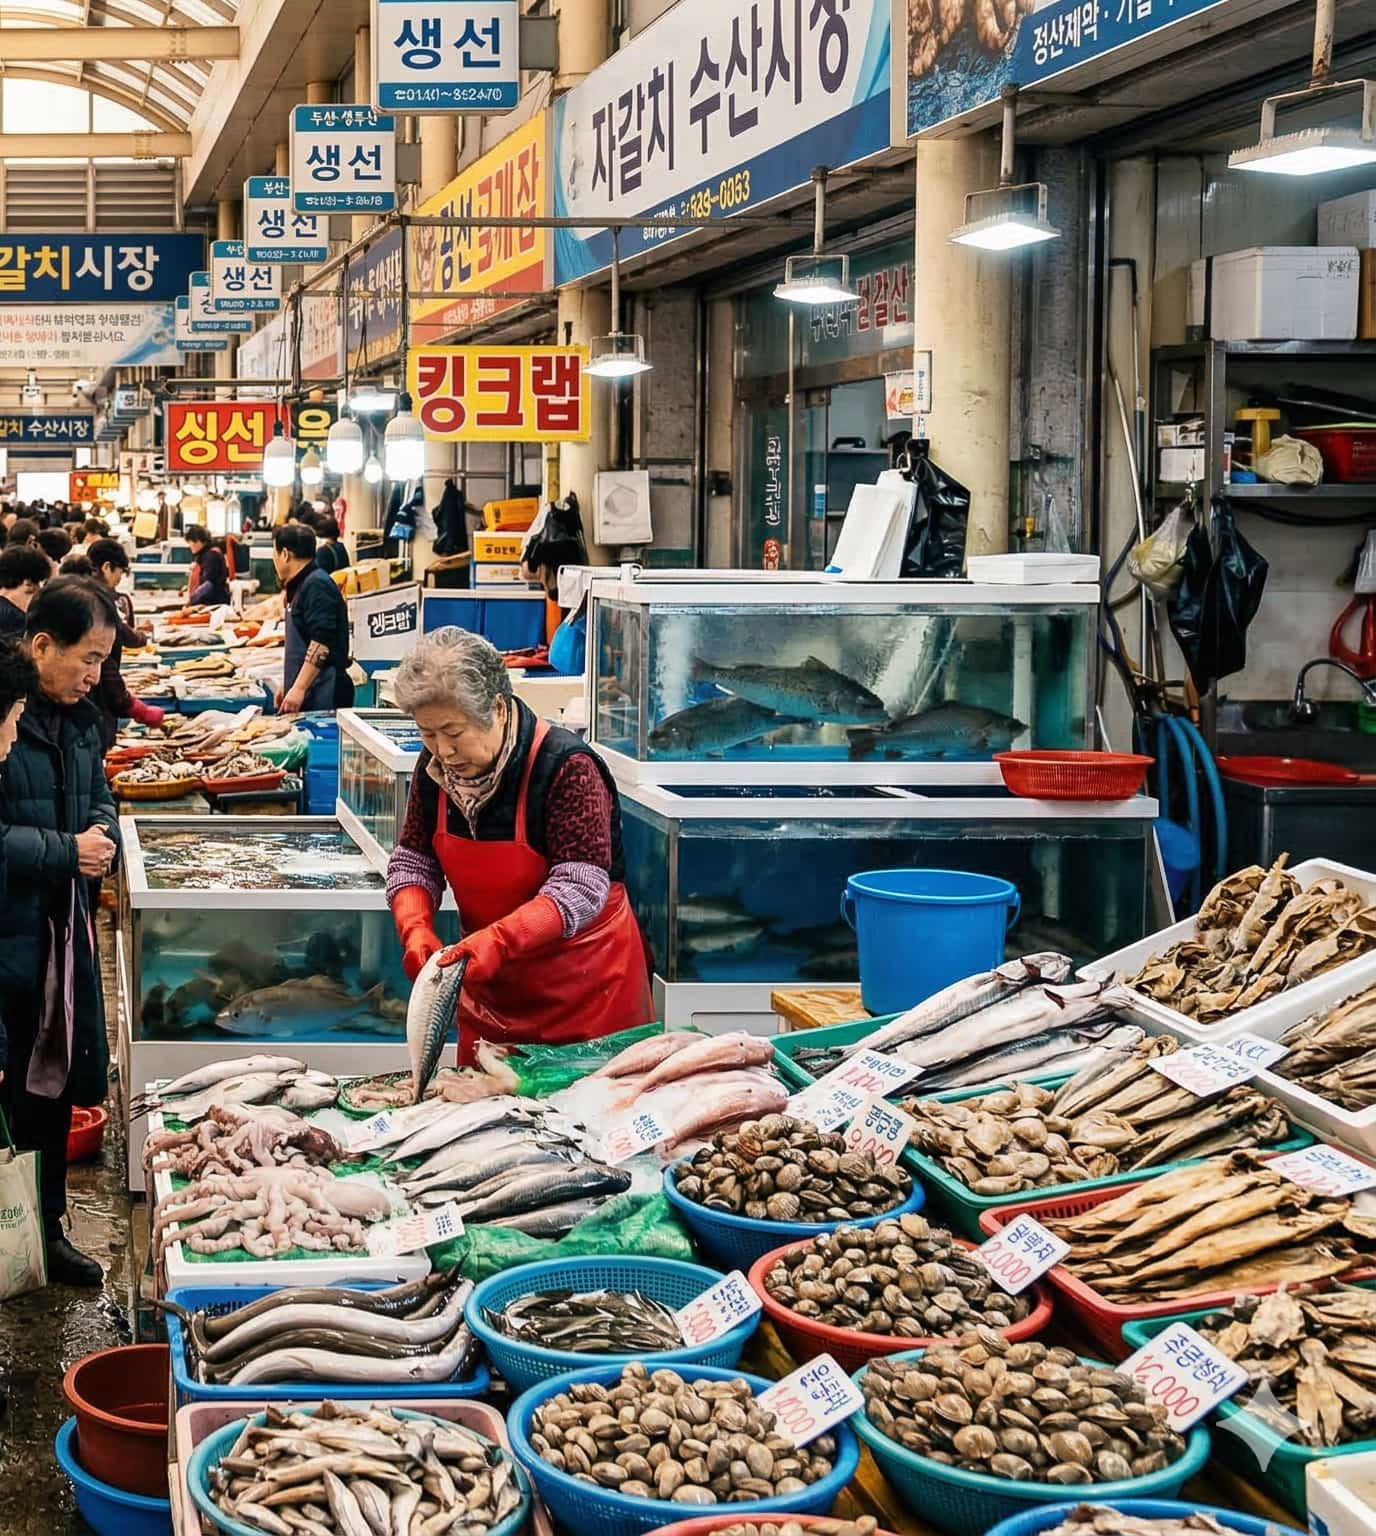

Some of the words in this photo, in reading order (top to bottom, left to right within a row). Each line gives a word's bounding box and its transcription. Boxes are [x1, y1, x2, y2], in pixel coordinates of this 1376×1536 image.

[393, 17, 501, 70] 생선
[591, 61, 675, 202] 자갈치
[689, 0, 850, 154] 수산시장
[305, 144, 382, 182] 생선
[257, 209, 318, 239] 생선
[222, 266, 273, 291] 생선
[415, 354, 581, 434] 킹크랩
[27, 419, 90, 439] 수산시장
[175, 411, 264, 465] 싱선
